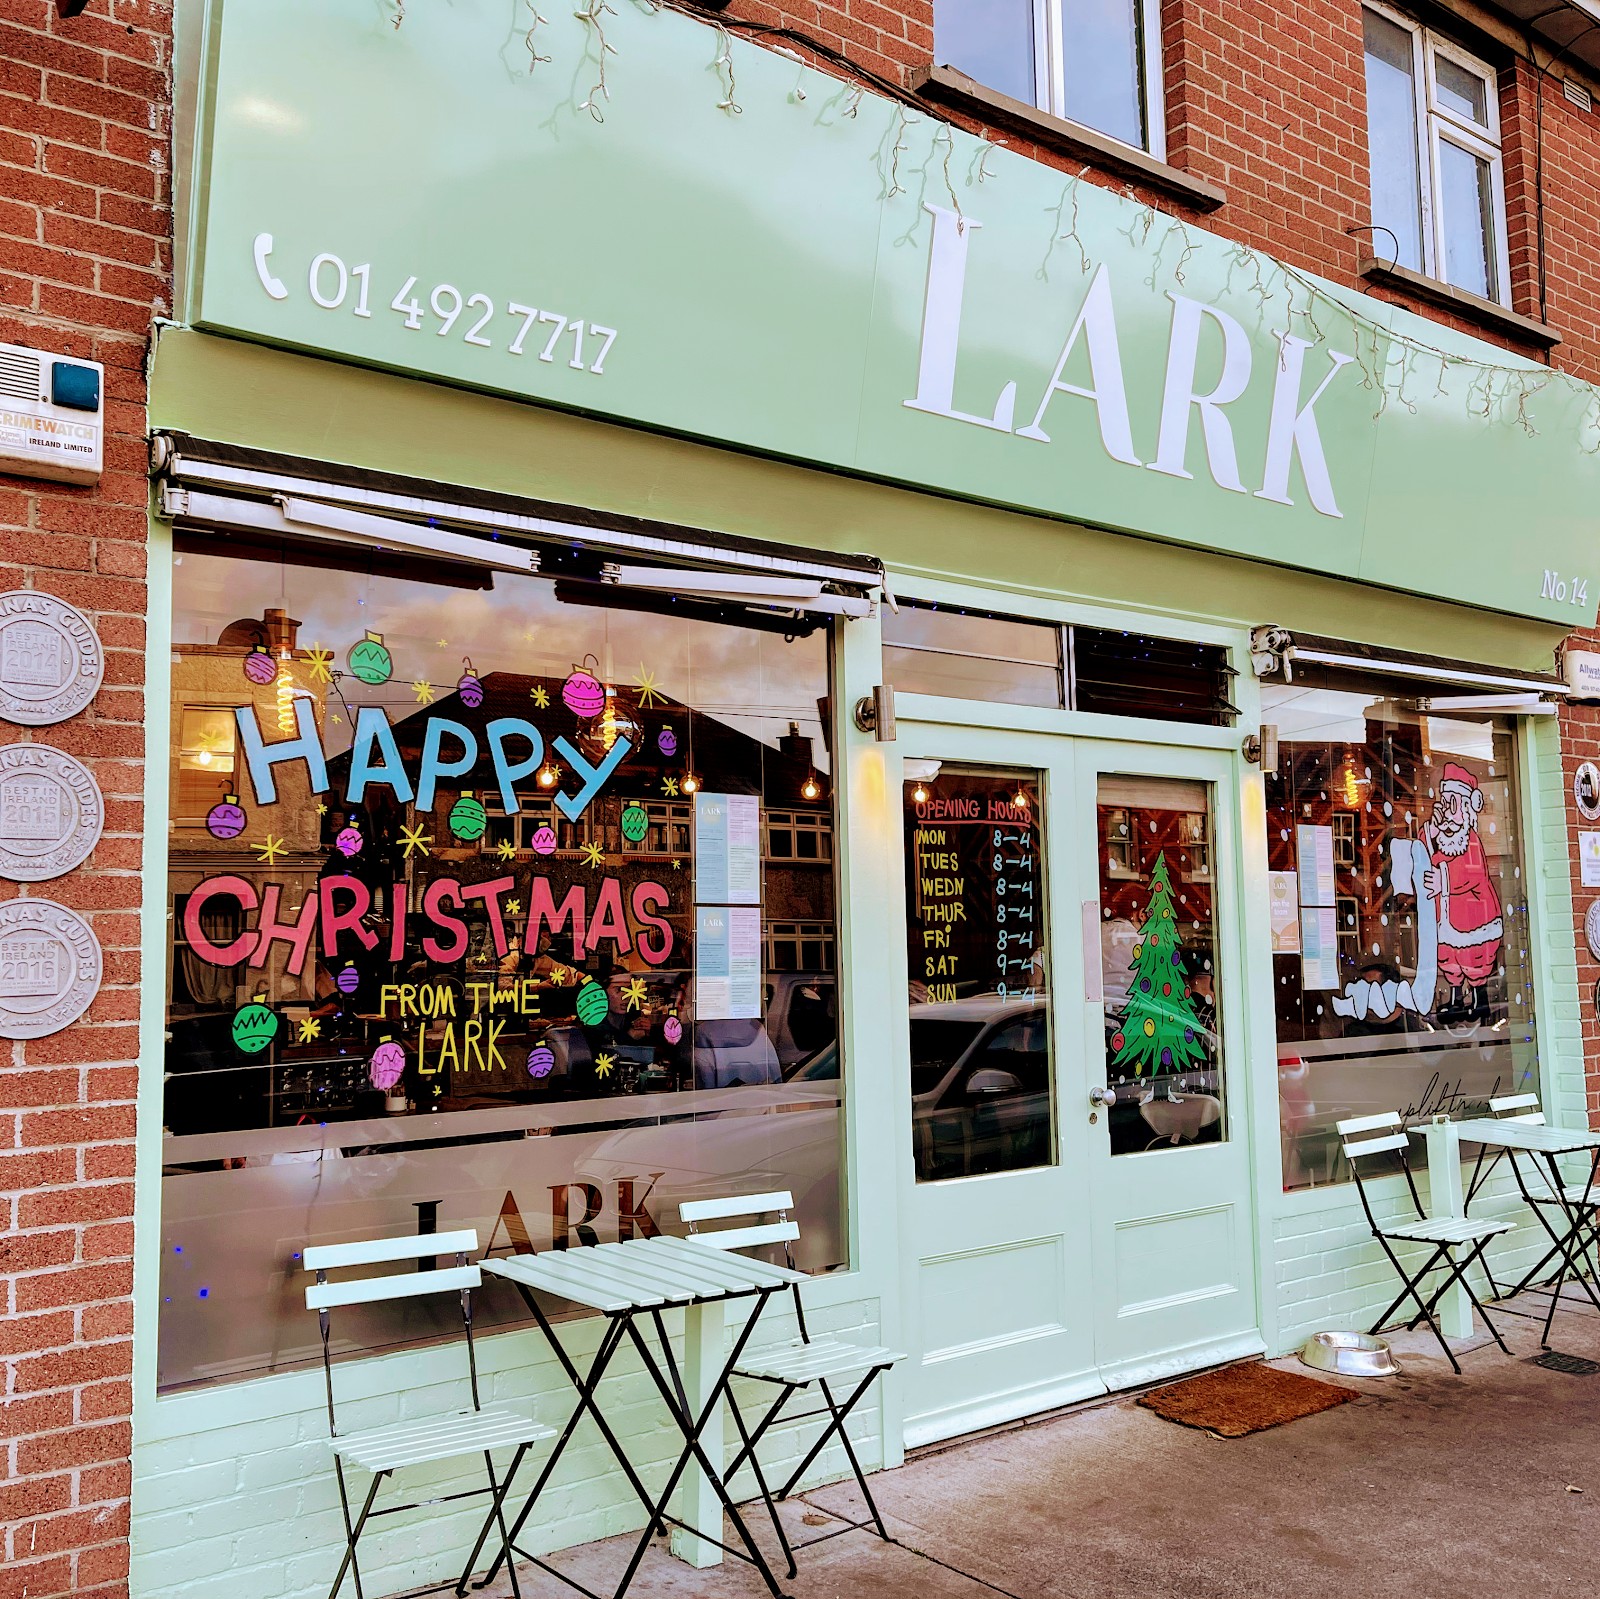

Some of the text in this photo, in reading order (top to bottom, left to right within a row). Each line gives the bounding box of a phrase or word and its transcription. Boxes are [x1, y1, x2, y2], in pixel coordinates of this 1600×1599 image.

[308, 252, 618, 374] 01 492 7717
[901, 201, 1355, 518] LARK
[29, 437, 93, 453] IRELAND LIMITED
[1541, 568, 1588, 607] No 14
[6, 631, 60, 643] BEST IN
[6, 640, 58, 652] IRELAND
[58, 610, 98, 678] GUIDES
[7, 649, 58, 671] 2014
[234, 697, 633, 822] HAPPY
[0, 749, 97, 829] NAS GUIDES
[4, 785, 58, 796] BEST IN
[4, 795, 57, 805] IRELAND
[5, 804, 56, 824] 2015
[701, 807, 721, 816] LARK
[915, 799, 1032, 823] OPENING HOURS
[916, 829, 946, 846] MON
[920, 852, 959, 872] TUES
[921, 877, 965, 896] WEDN
[922, 902, 967, 922] THUR
[183, 872, 676, 977] CHRISTMAS
[703, 918, 725, 927] LARK
[0, 904, 96, 982] NAS GUIDES
[2, 942, 56, 951] BEST IN
[2, 951, 55, 961] IRELAND
[925, 955, 958, 977] SAT
[2, 960, 55, 980] 2016
[380, 983, 457, 1019] FROM
[926, 983, 957, 1006] SUN
[418, 1019, 507, 1075] LARK
